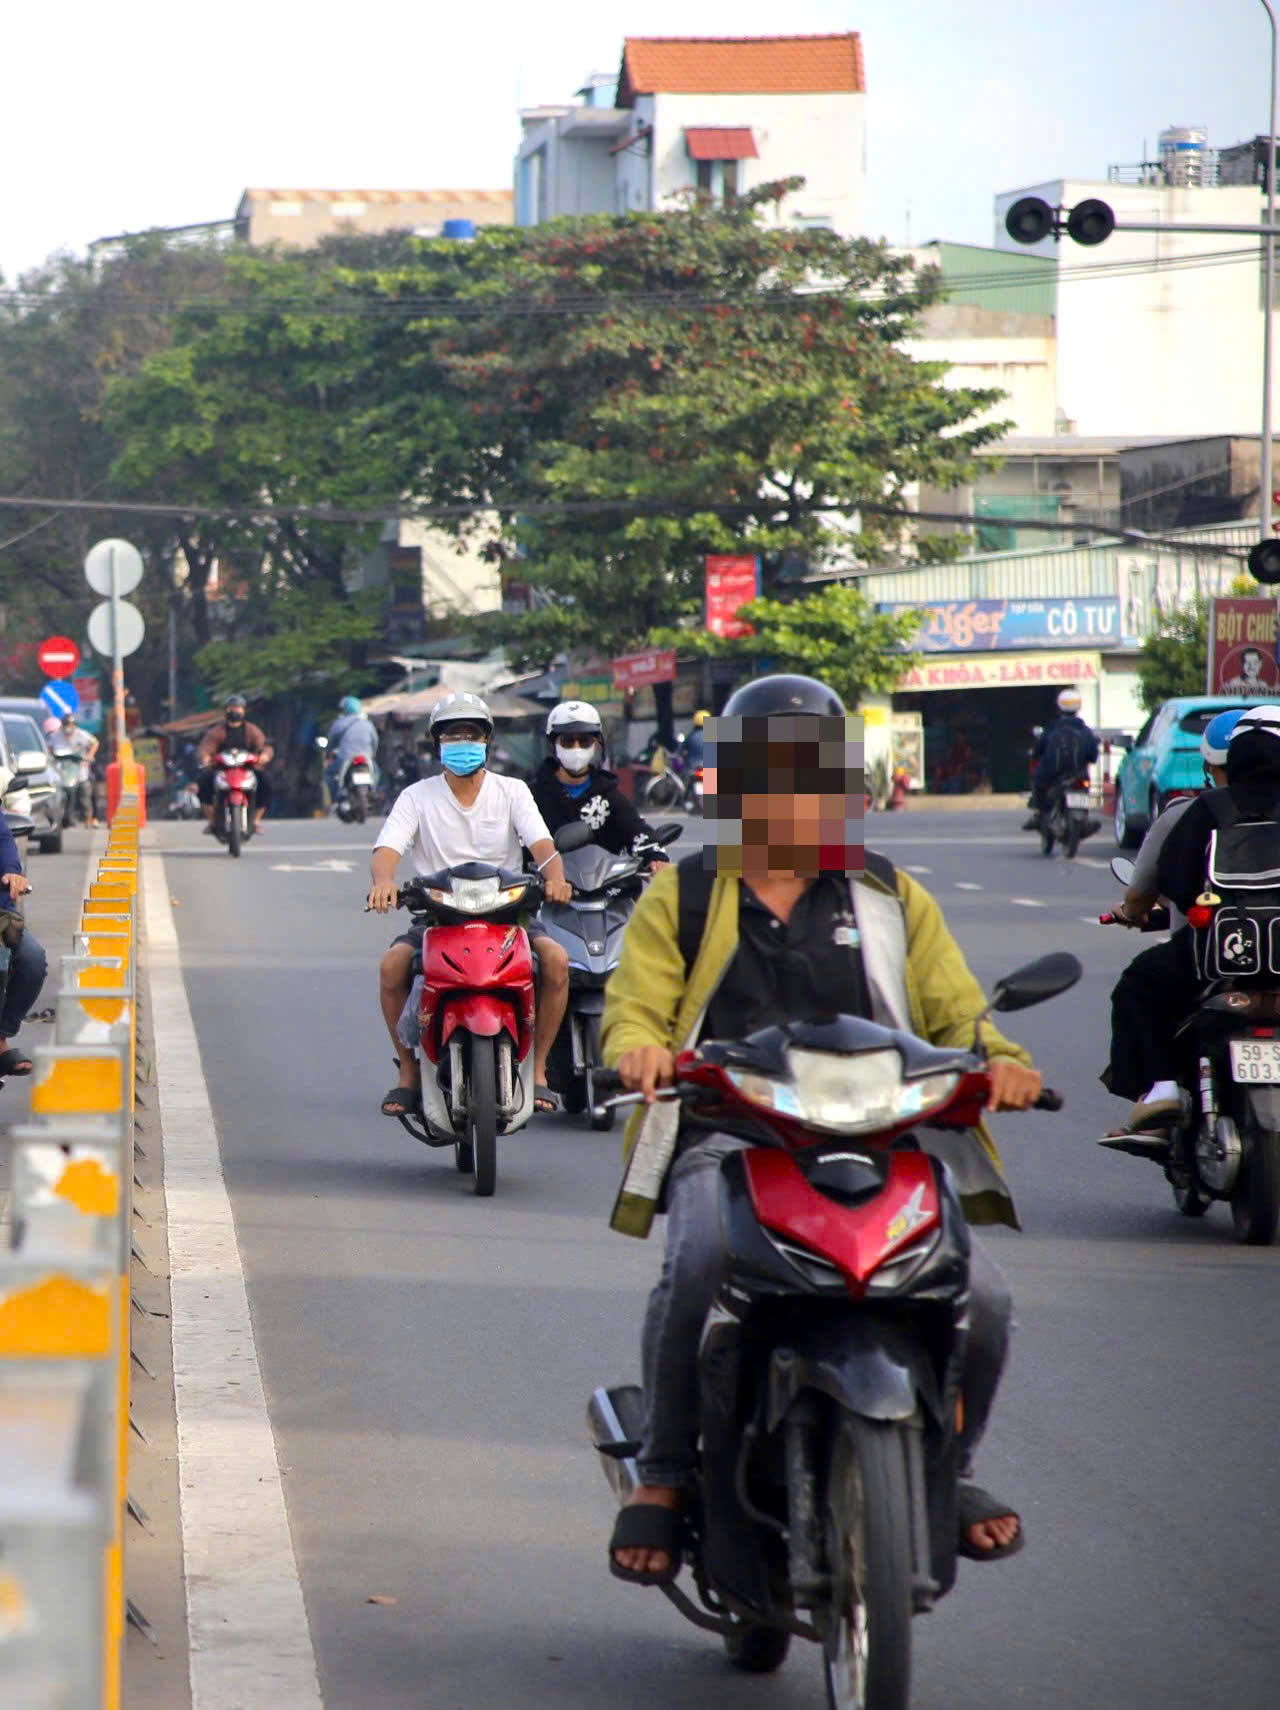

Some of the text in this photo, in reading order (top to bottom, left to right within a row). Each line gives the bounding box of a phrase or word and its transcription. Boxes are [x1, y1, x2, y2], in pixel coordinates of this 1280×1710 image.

[1047, 601, 1116, 635] CÔ TƯ
[1217, 607, 1244, 648] BỘT
